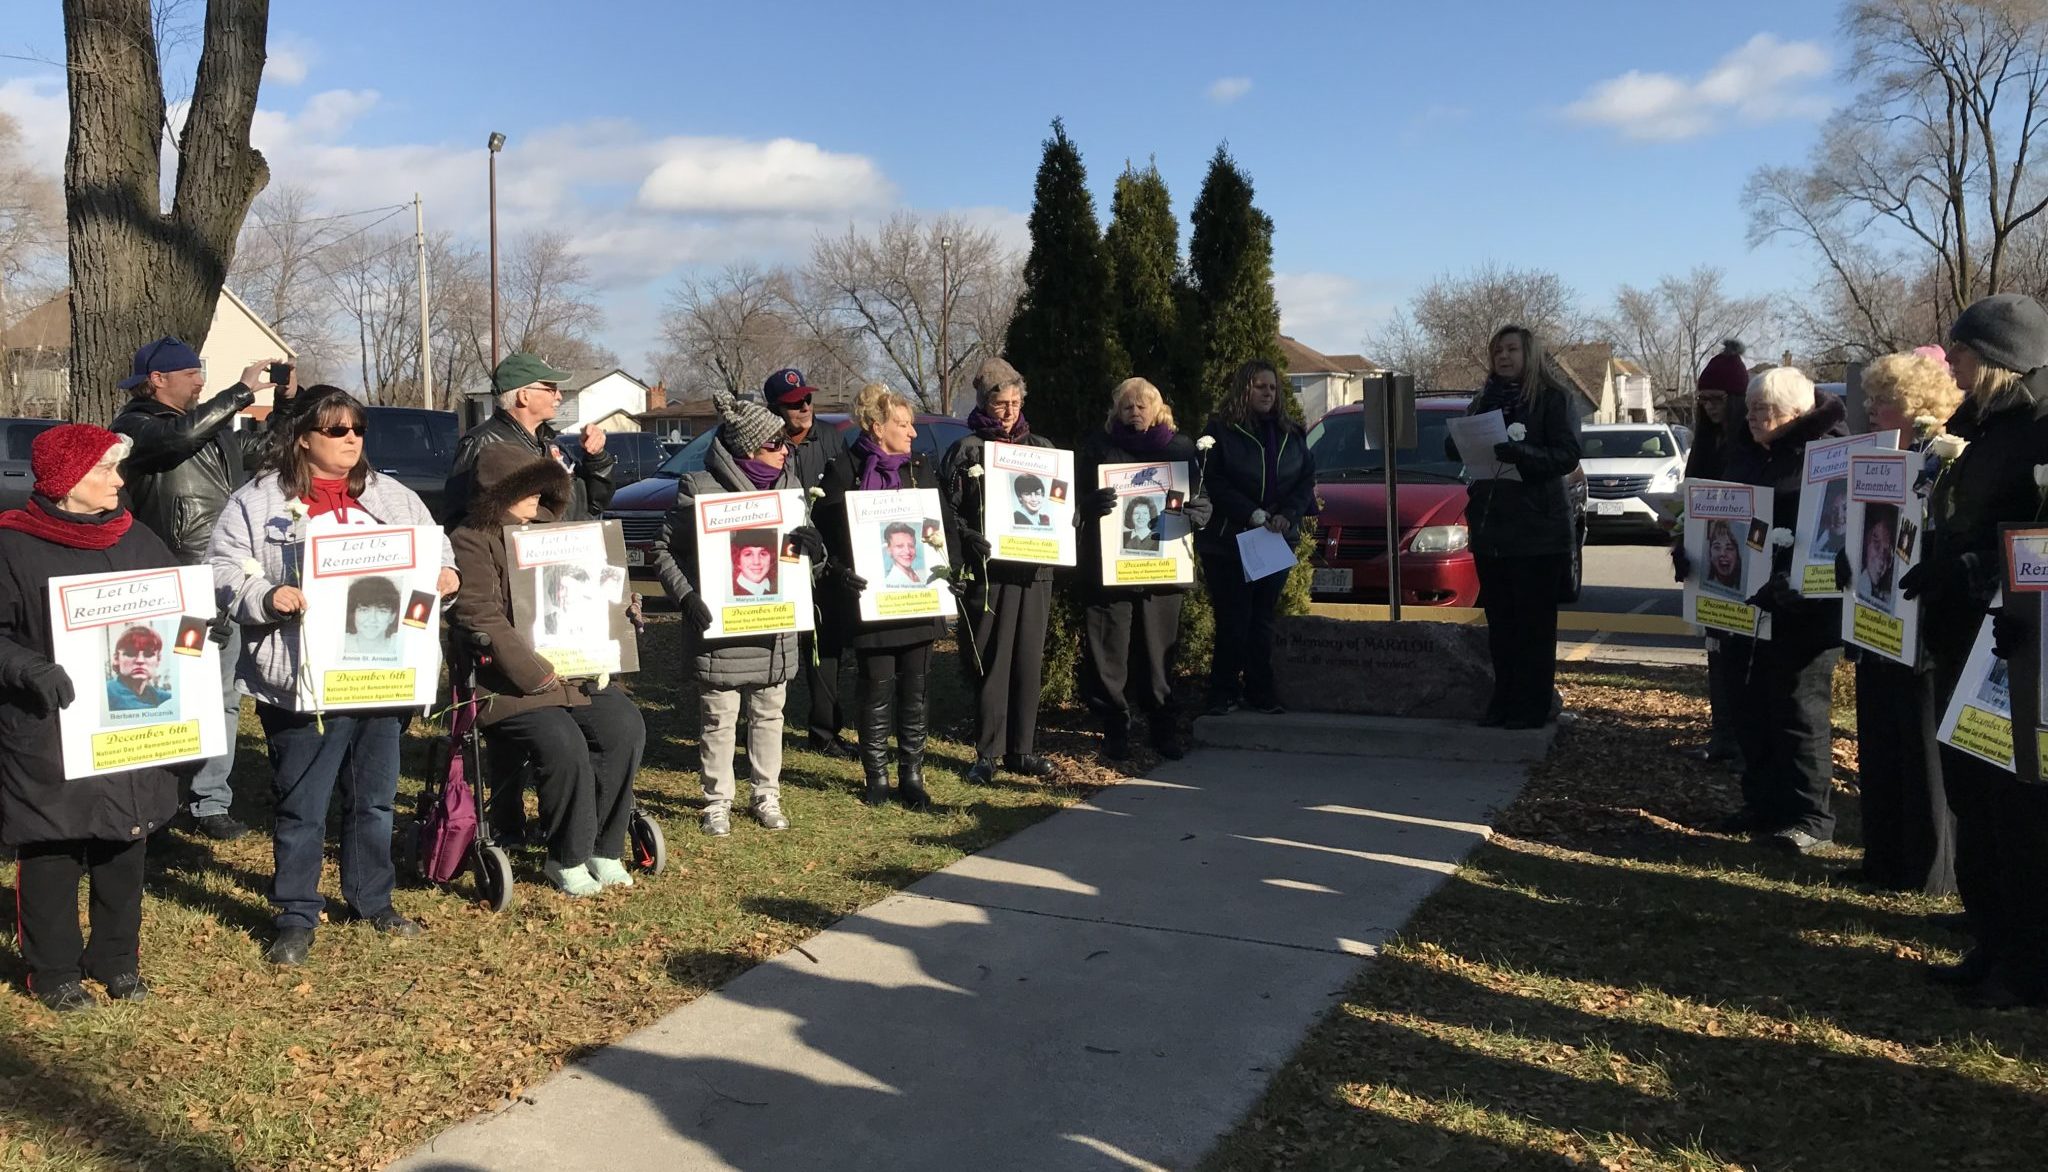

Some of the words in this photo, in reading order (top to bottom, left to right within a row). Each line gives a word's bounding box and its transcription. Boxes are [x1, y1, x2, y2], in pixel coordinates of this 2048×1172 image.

[1827, 449, 1843, 460] Let
[1865, 464, 1878, 474] Let
[1880, 464, 1890, 475] Us
[724, 503, 741, 513] Let
[745, 501, 759, 510] Us
[342, 540, 364, 551] Let
[370, 538, 387, 549] Us
[96, 586, 122, 600] Let
[129, 582, 149, 594] Us
[73, 596, 176, 619] Remember...
[732, 606, 771, 616] December
[1704, 600, 1735, 612] December
[1275, 634, 1287, 646] In
[1291, 634, 1343, 651] Memory
[1346, 636, 1360, 651] of
[336, 672, 385, 682] December
[389, 671, 406, 680] 6th
[110, 712, 140, 720] Barbara
[1967, 711, 2001, 731] December
[107, 729, 164, 744] December
[169, 724, 188, 734] 6th
[96, 748, 122, 756] National
[144, 739, 186, 748] Remembrance
[127, 754, 152, 762] Violence
[154, 750, 177, 758] Against
